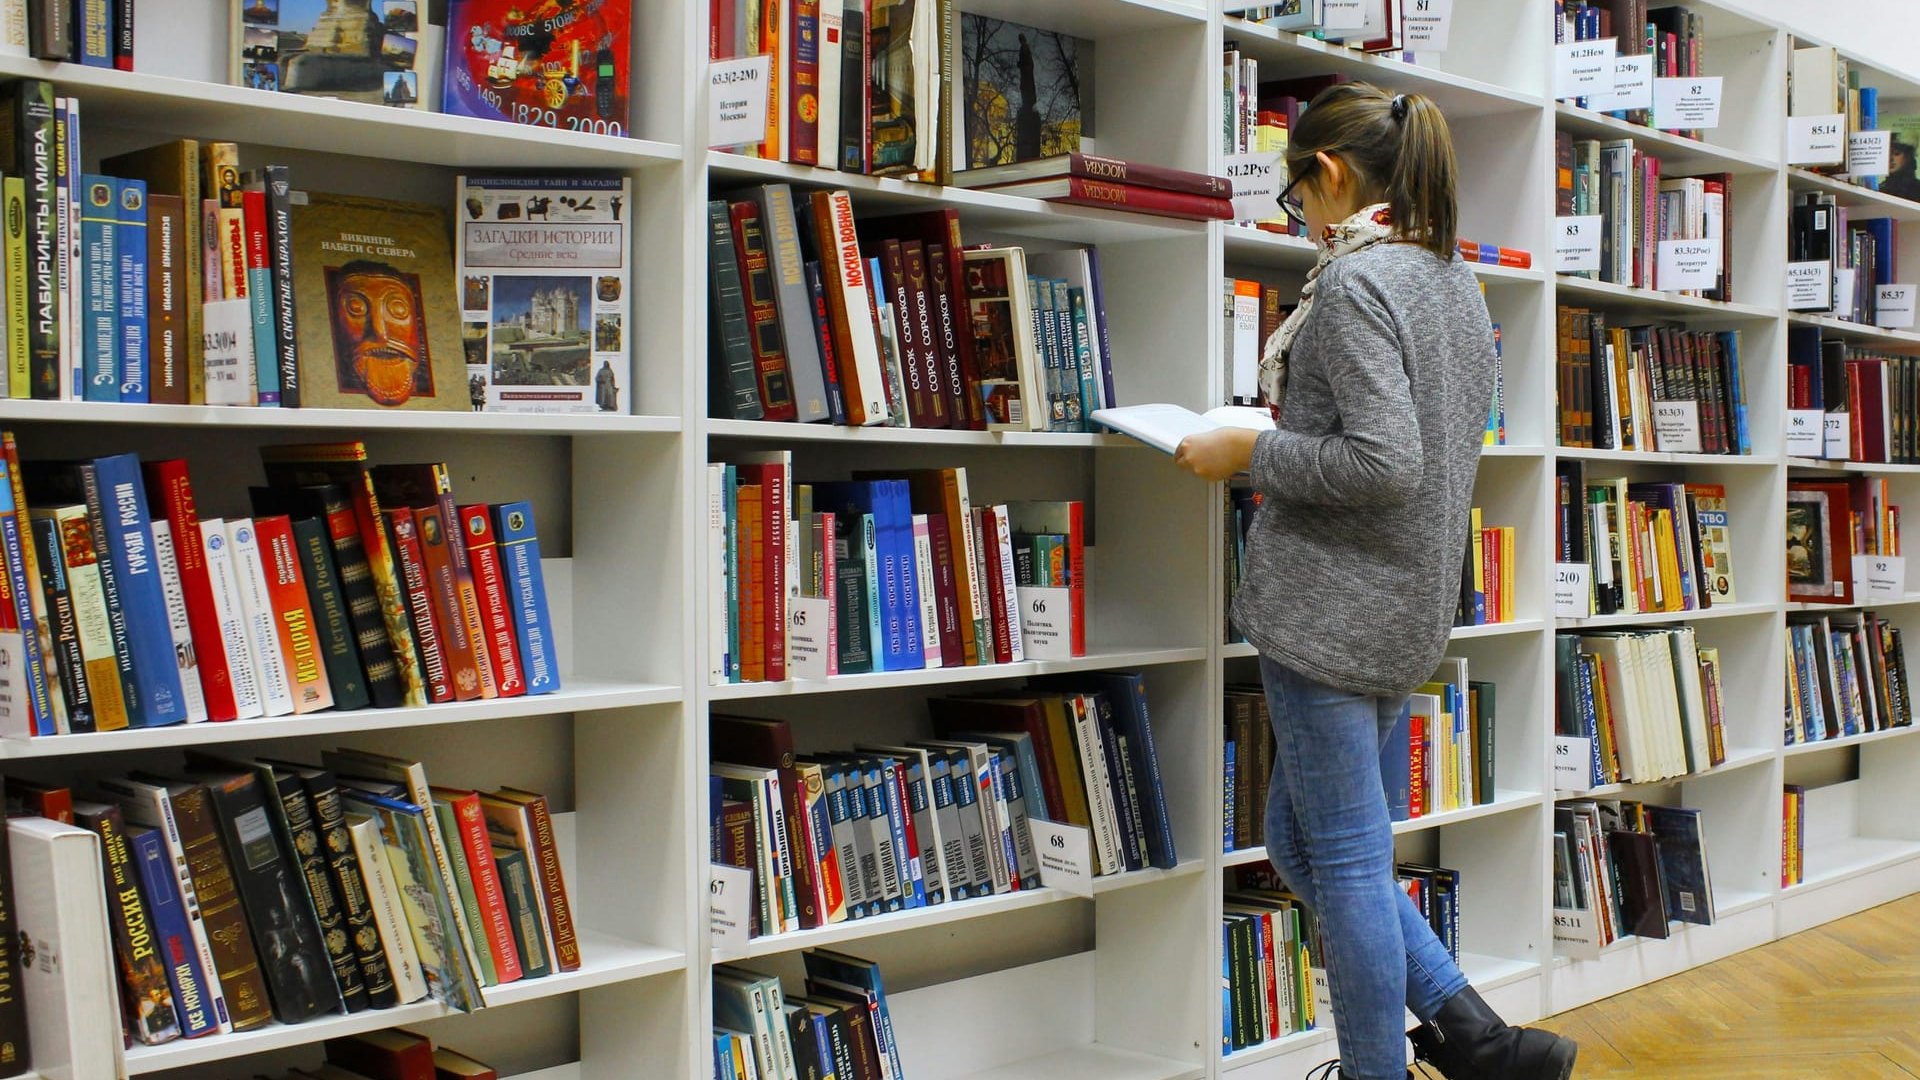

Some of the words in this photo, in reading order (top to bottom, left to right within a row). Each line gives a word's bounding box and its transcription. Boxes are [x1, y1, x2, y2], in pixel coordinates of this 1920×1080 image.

[1570, 49, 1604, 59] 81.2Нем
[477, 84, 503, 113] 1492
[720, 99, 748, 111] История
[1691, 86, 1702, 95] 82
[720, 112, 748, 122] Москвы
[1811, 125, 1837, 135] 85.14
[34, 127, 48, 191] МИРА
[1085, 159, 1127, 178] МОСКВА
[1227, 164, 1271, 177] 81.2Рус
[1253, 188, 1270, 197] язык
[341, 232, 395, 246] ВИКИНГИ:
[474, 229, 539, 244] ЗАГАДКИ
[543, 229, 614, 245] ИСТОРИИ
[832, 194, 856, 244] ВОЕННАЯ
[1566, 225, 1579, 236] 83
[13, 246, 22, 271] МИРА
[276, 208, 290, 277] ЗАБРАЛОМ
[321, 241, 364, 254] НАБЕГИ
[367, 245, 375, 254] С
[376, 246, 416, 259] СЕВЕРА
[509, 249, 553, 261] Средние
[556, 250, 578, 260] века
[776, 239, 806, 286] МОСКВА
[36, 198, 52, 333] ЛАБИРИНТЫ
[839, 243, 864, 288] МОСКВА
[1788, 267, 1822, 277] 85.143(3)
[13, 275, 24, 324] ДРЕВНЕГО
[278, 280, 293, 340] СКРЫТЫЕ
[895, 286, 913, 343] СОРОКОВ
[1881, 290, 1905, 301] 85.37
[915, 290, 931, 346] СОРОКОВ
[938, 293, 954, 349] СОРОКОВ
[1075, 321, 1089, 348] МИР
[15, 328, 25, 373] ИСТОРИЯ
[281, 343, 296, 389] ТАЙНЫ,
[905, 347, 920, 390] СОРОК
[924, 350, 938, 392] СОРОК
[1078, 350, 1093, 380] ВЕСЬ
[947, 353, 961, 395] СОРОК
[1658, 408, 1685, 417] 83.3(3)
[1792, 417, 1804, 427] 86
[114, 481, 139, 526] РОССИИ
[5, 520, 22, 572] ИСТОРИЯ
[123, 530, 148, 574] ГОРОДА
[307, 535, 329, 589] России
[1876, 562, 1887, 572] 92
[14, 575, 30, 621] РОССИИ
[99, 558, 120, 609] ЦАРСКИЕ
[885, 556, 896, 607] МОСКВИЧИ
[902, 556, 912, 605] МОСКВИЧИ
[321, 590, 346, 655] История
[793, 610, 807, 626] 65
[1032, 599, 1046, 614] 66
[24, 627, 38, 659] АТЛАС
[109, 609, 133, 672] ДИНАСТИИ
[283, 607, 317, 684] ИСТОРИЯ
[409, 589, 444, 684] ЭНЦИКЛОПЕДИЯ
[891, 636, 899, 653] МЫ
[908, 636, 916, 652] МЫ
[30, 659, 49, 719] ШКОЛЬНИКА
[1587, 699, 1594, 715] XX
[1556, 744, 1569, 755] 85
[1589, 718, 1604, 780] ИСКУССТВО
[100, 818, 119, 865] МОНАРХИ
[113, 834, 128, 864] МИРА
[774, 808, 790, 876] ПРИЗЫВНИКА
[922, 846, 937, 874] ДЕТЯХ
[967, 832, 989, 881] ПРАВОСУДИЕ
[1050, 835, 1065, 849] 68
[111, 865, 124, 885] ВСЕ
[541, 848, 561, 892] РУССКОЙ
[710, 880, 725, 895] 67
[878, 839, 898, 895] ЖЕНЩИНАМ
[118, 884, 154, 961] РОССИЯ
[551, 894, 571, 939] ИСТОРИЯ
[1554, 917, 1582, 929] 85.11
[172, 962, 203, 1011] МОНАРХИ
[187, 1009, 207, 1030] ВСЕ
